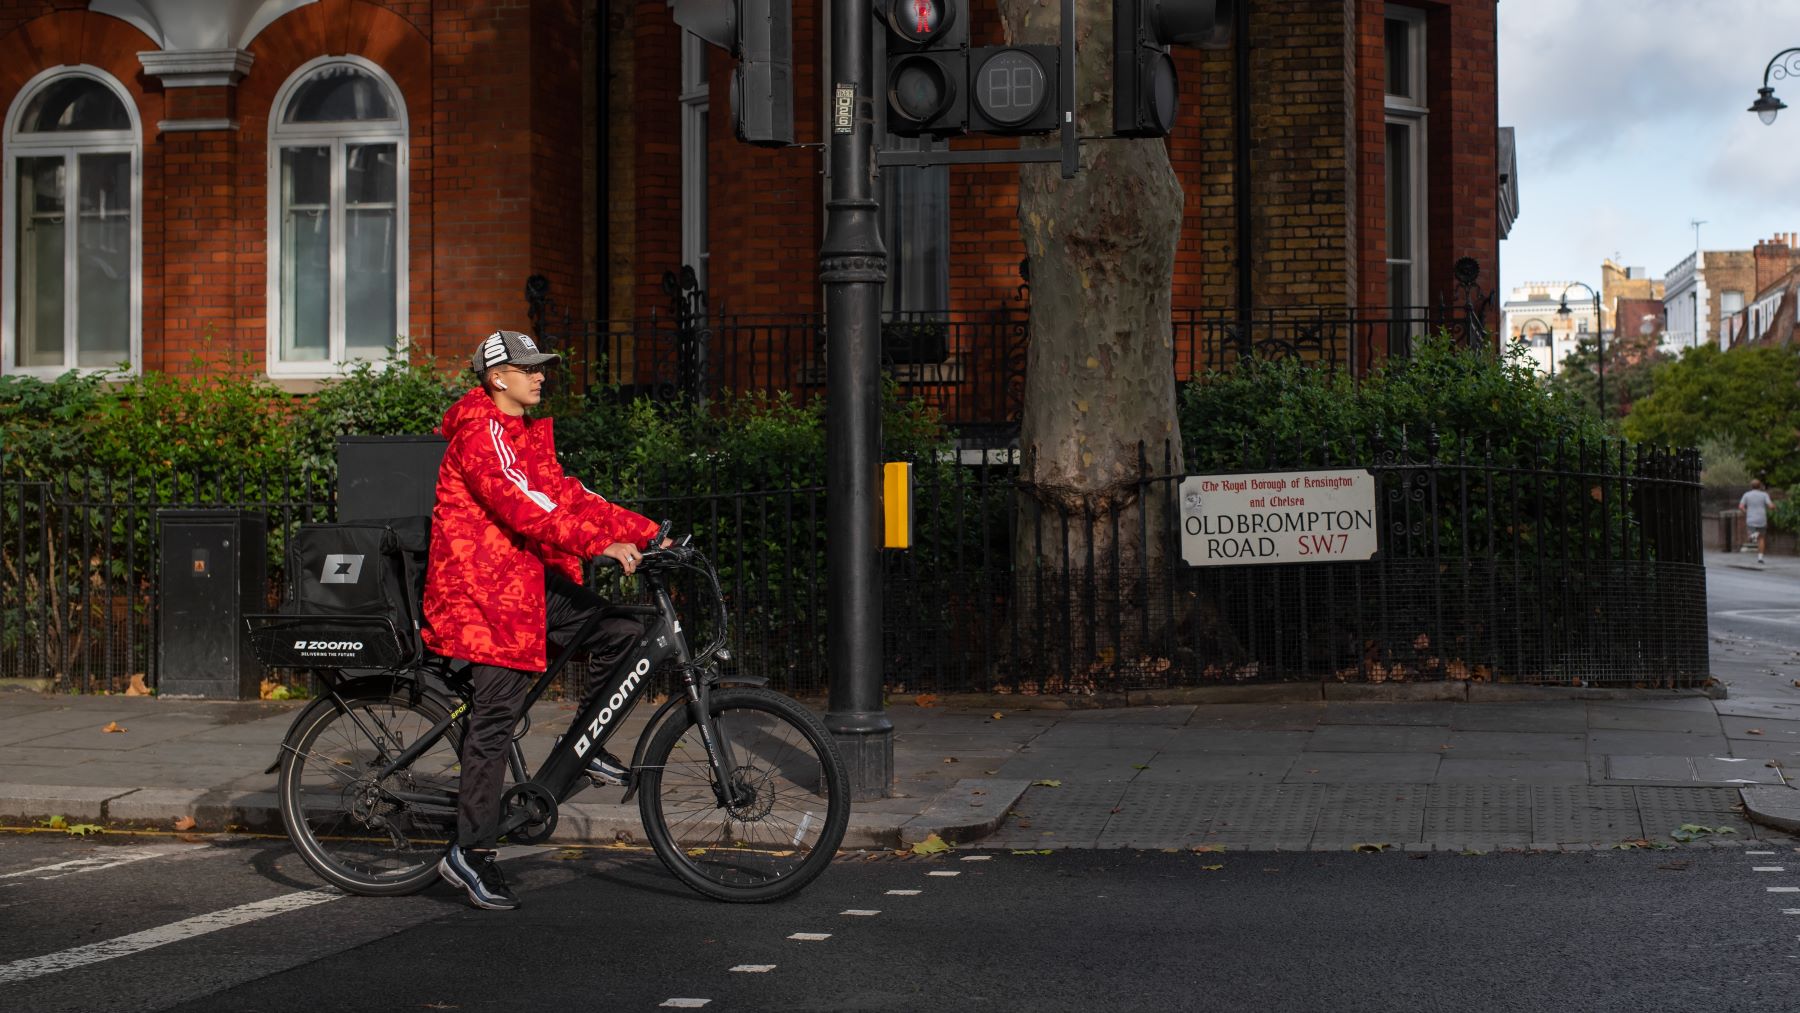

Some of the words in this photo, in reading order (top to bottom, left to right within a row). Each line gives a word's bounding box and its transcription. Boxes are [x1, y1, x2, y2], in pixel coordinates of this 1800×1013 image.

[1202, 481, 1219, 492] The
[1221, 480, 1248, 494] Royal
[1251, 479, 1287, 492] Borough
[1291, 477, 1301, 489] of
[1304, 476, 1353, 490] Kensington
[1249, 497, 1265, 508] and
[1270, 496, 1305, 508] Chelsea
[308, 641, 363, 650] zoomo
[588, 658, 650, 740] zoomo
